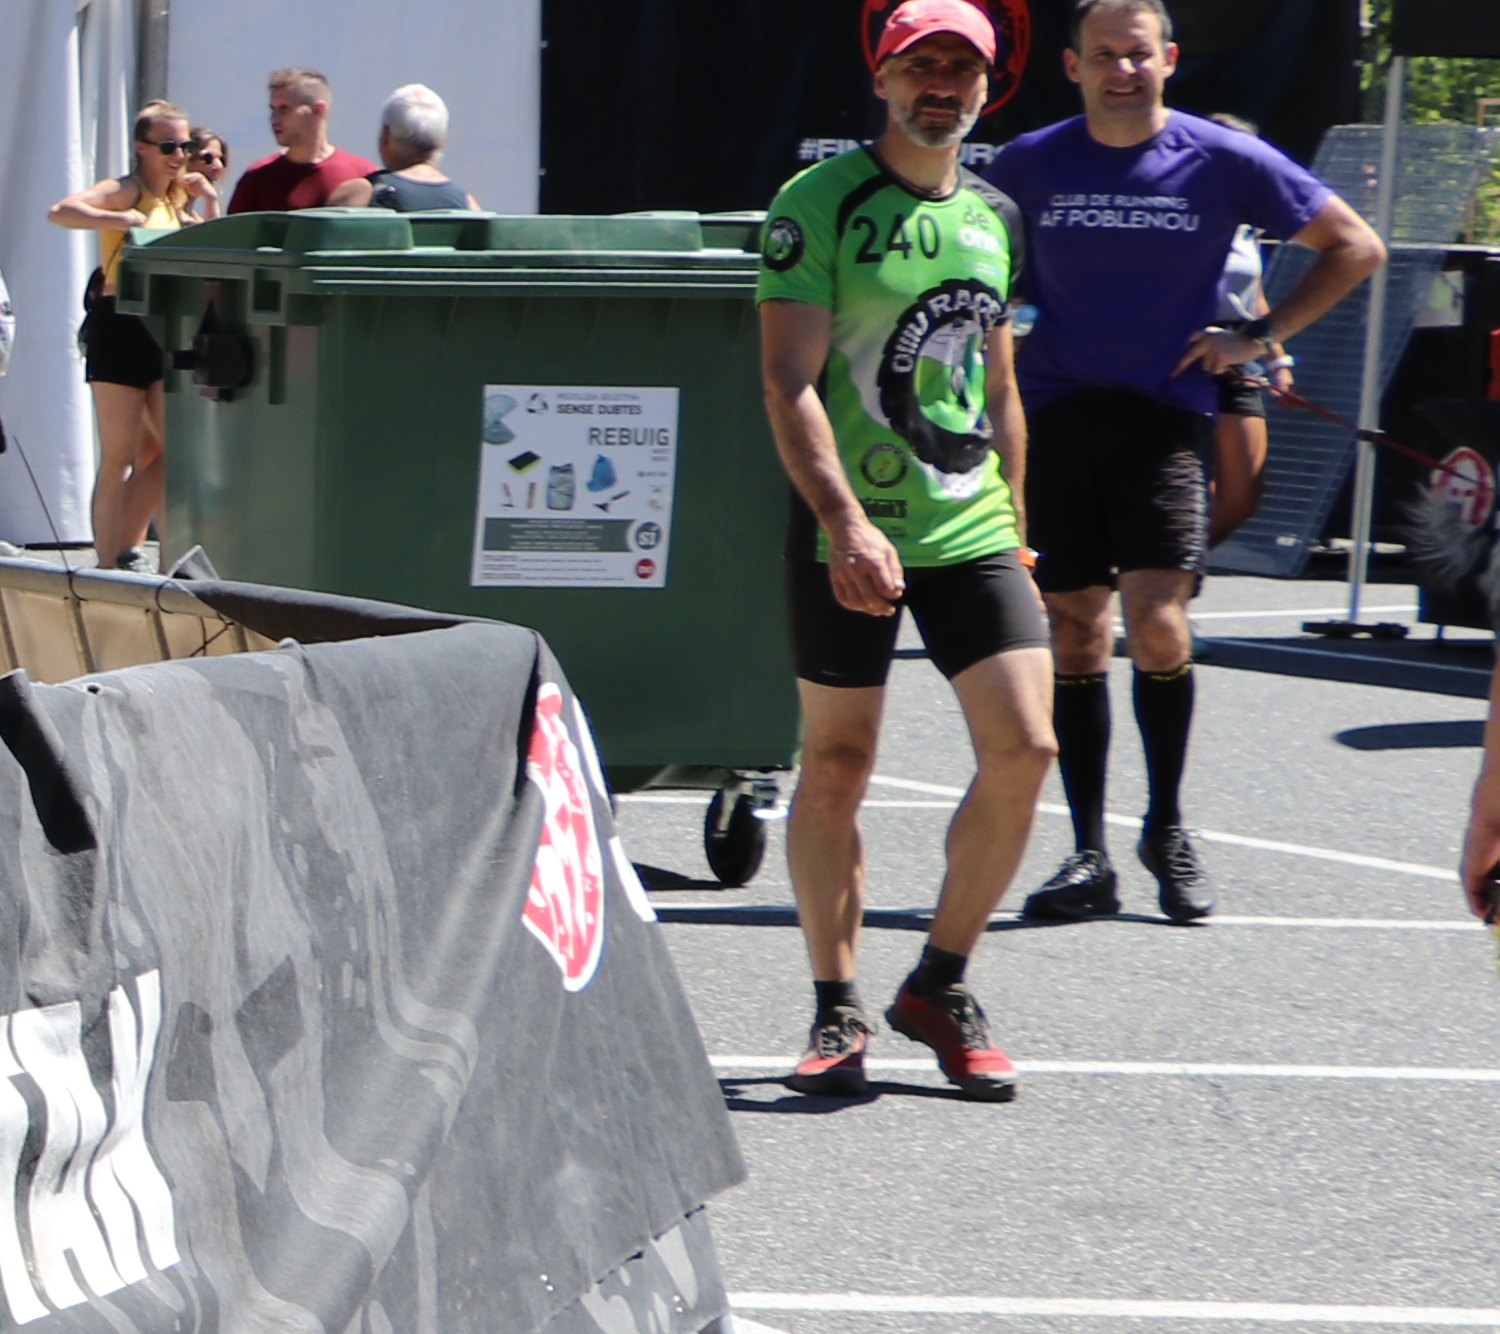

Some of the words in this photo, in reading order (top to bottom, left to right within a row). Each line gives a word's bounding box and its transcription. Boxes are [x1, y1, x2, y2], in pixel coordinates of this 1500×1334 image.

[1050, 194, 1088, 207] CLUB
[1089, 194, 1113, 207] DE
[1066, 209, 1200, 232] POBLENOU
[852, 213, 942, 264] 240
[588, 427, 670, 446] REBUIG
